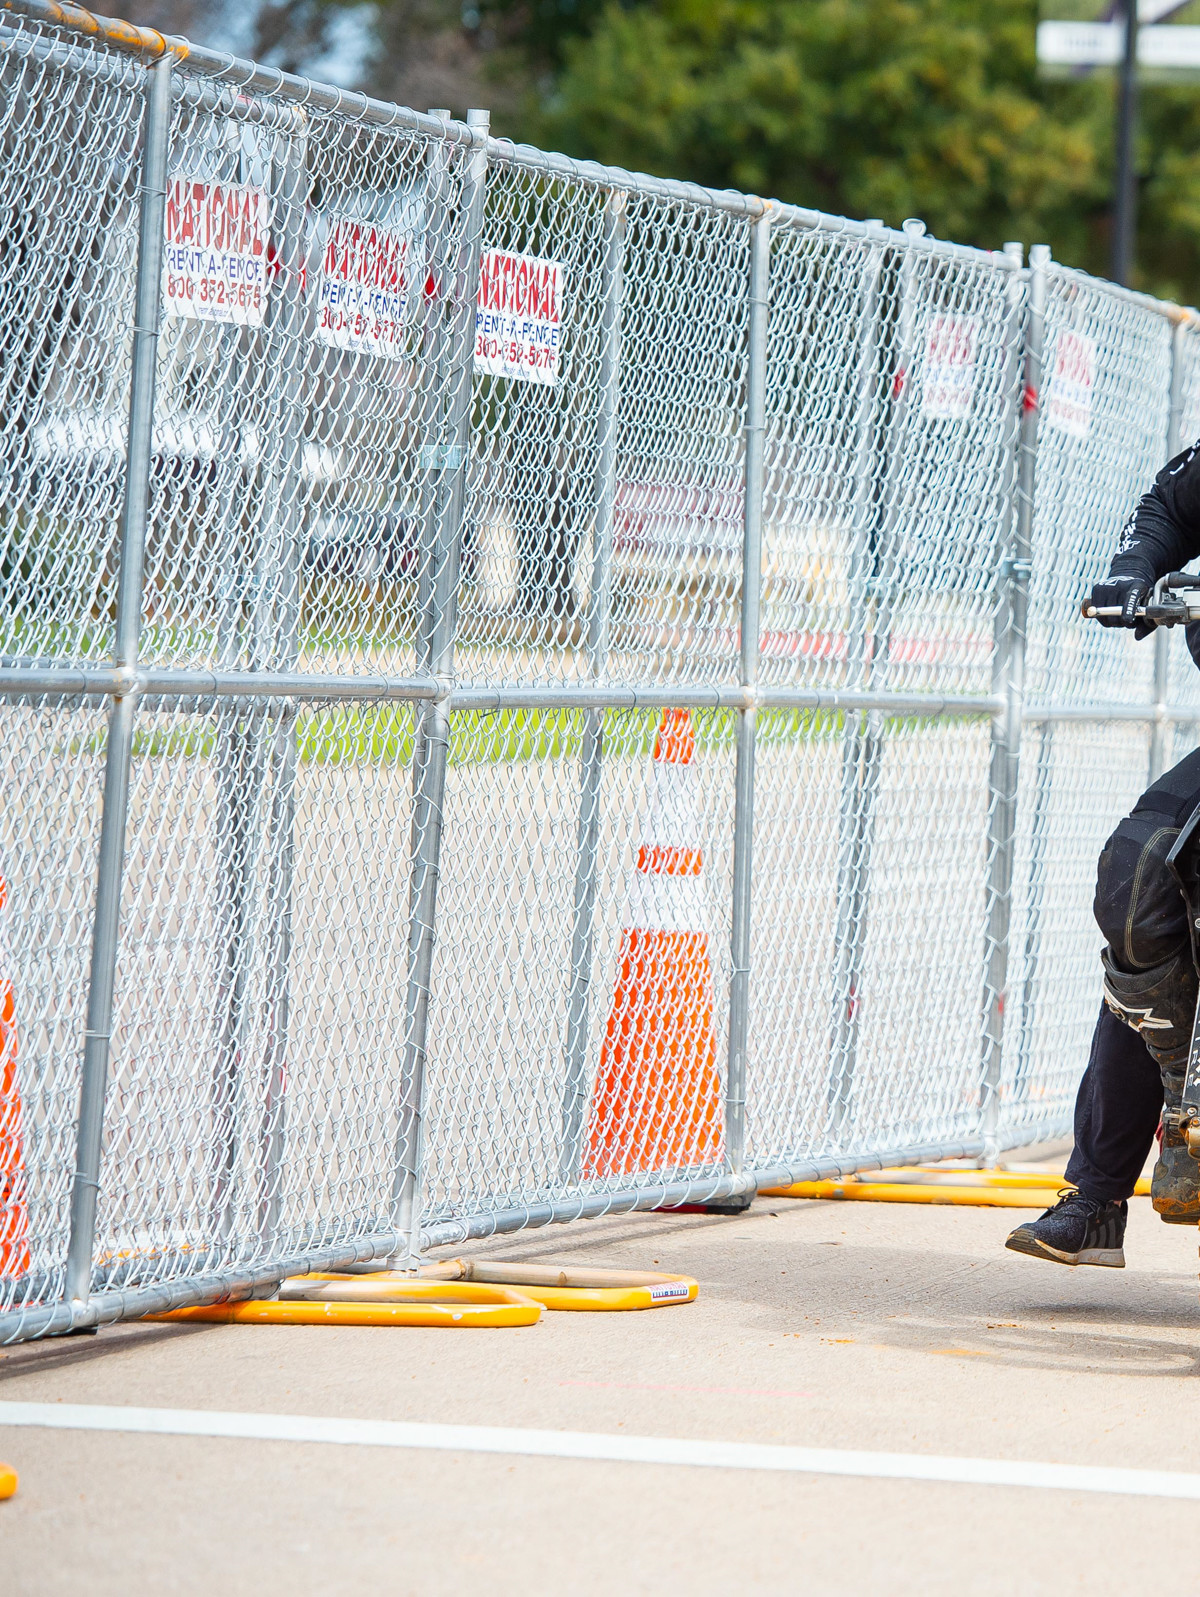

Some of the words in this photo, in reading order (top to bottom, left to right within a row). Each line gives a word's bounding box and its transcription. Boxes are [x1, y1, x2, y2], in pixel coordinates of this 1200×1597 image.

[167, 180, 263, 256] NATIONAL
[167, 248, 263, 282] RENTA-ENCE
[477, 252, 559, 323] NATIONAL
